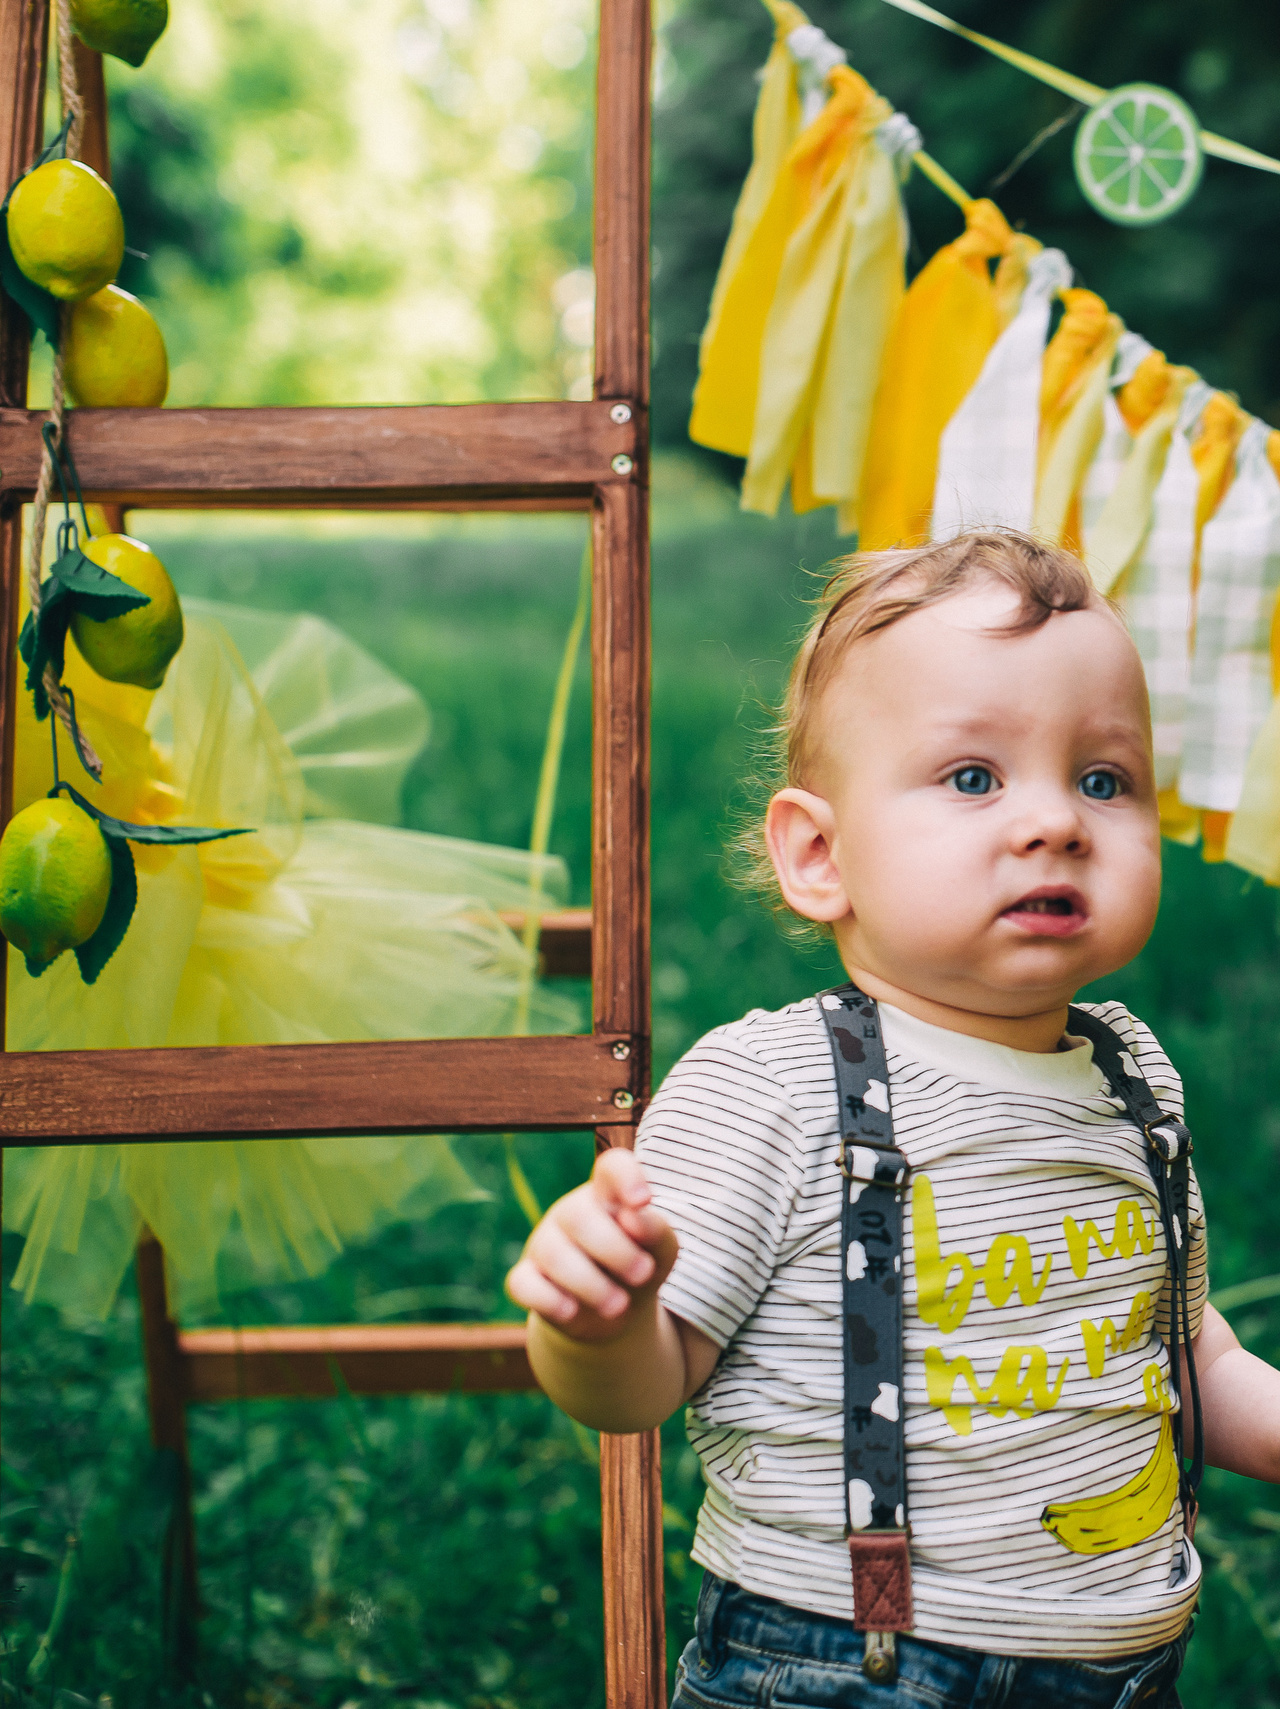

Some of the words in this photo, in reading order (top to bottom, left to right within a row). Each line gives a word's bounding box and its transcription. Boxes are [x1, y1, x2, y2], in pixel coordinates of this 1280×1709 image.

[912, 1174, 1053, 1335] ba
[1062, 1199, 1156, 1279] na
[924, 1345, 1070, 1436] na
